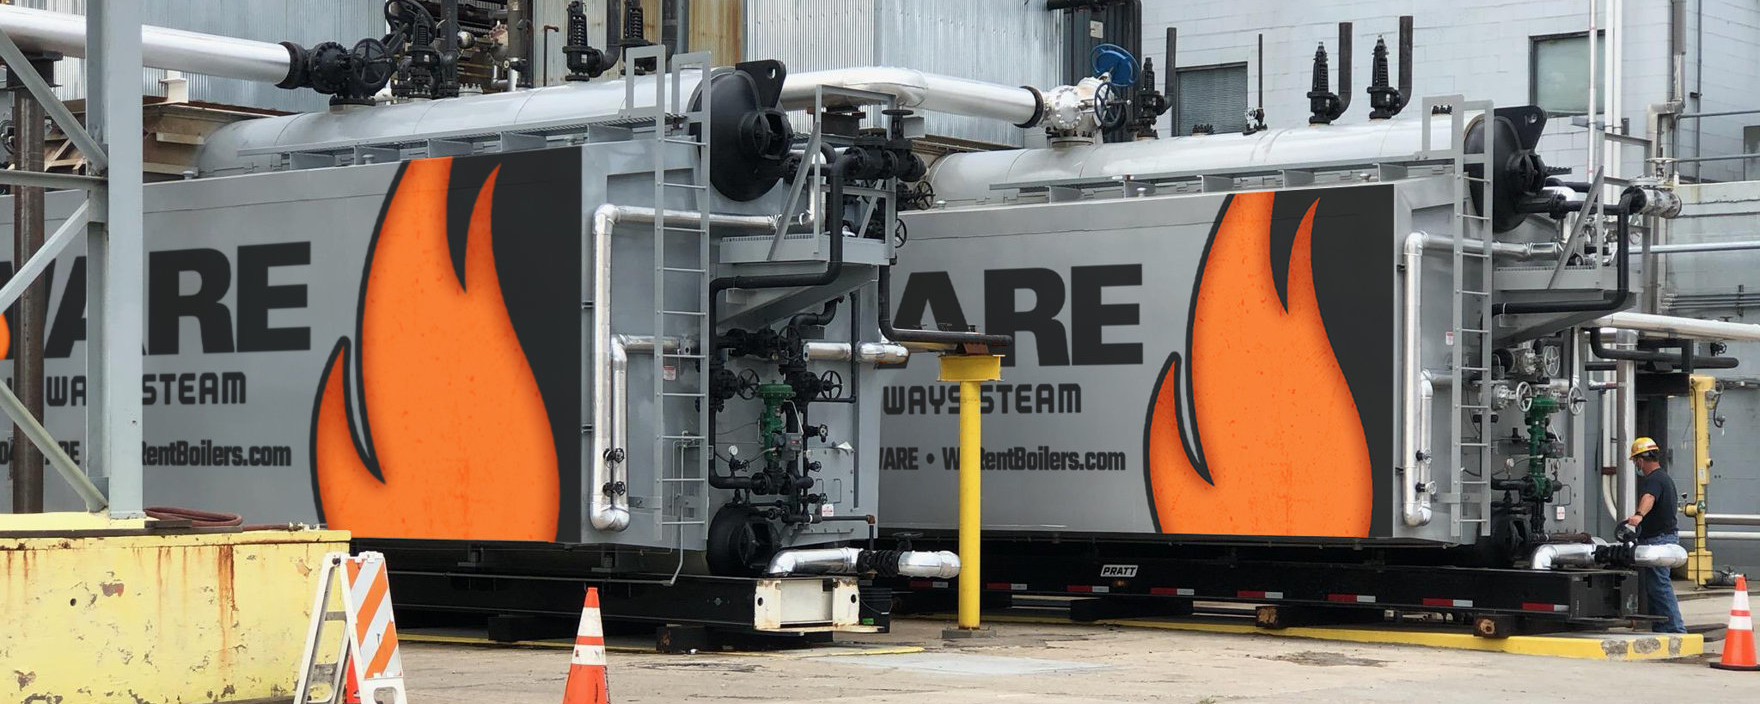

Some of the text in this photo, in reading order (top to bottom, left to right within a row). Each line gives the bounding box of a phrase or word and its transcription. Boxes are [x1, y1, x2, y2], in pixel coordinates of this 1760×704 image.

[0, 241, 311, 360] RE
[142, 370, 247, 406] STEAM
[883, 383, 1082, 415] WAYS STEAM
[880, 446, 1126, 471] ARE WentBoilers.com
[1102, 566, 1137, 576] PRATT
